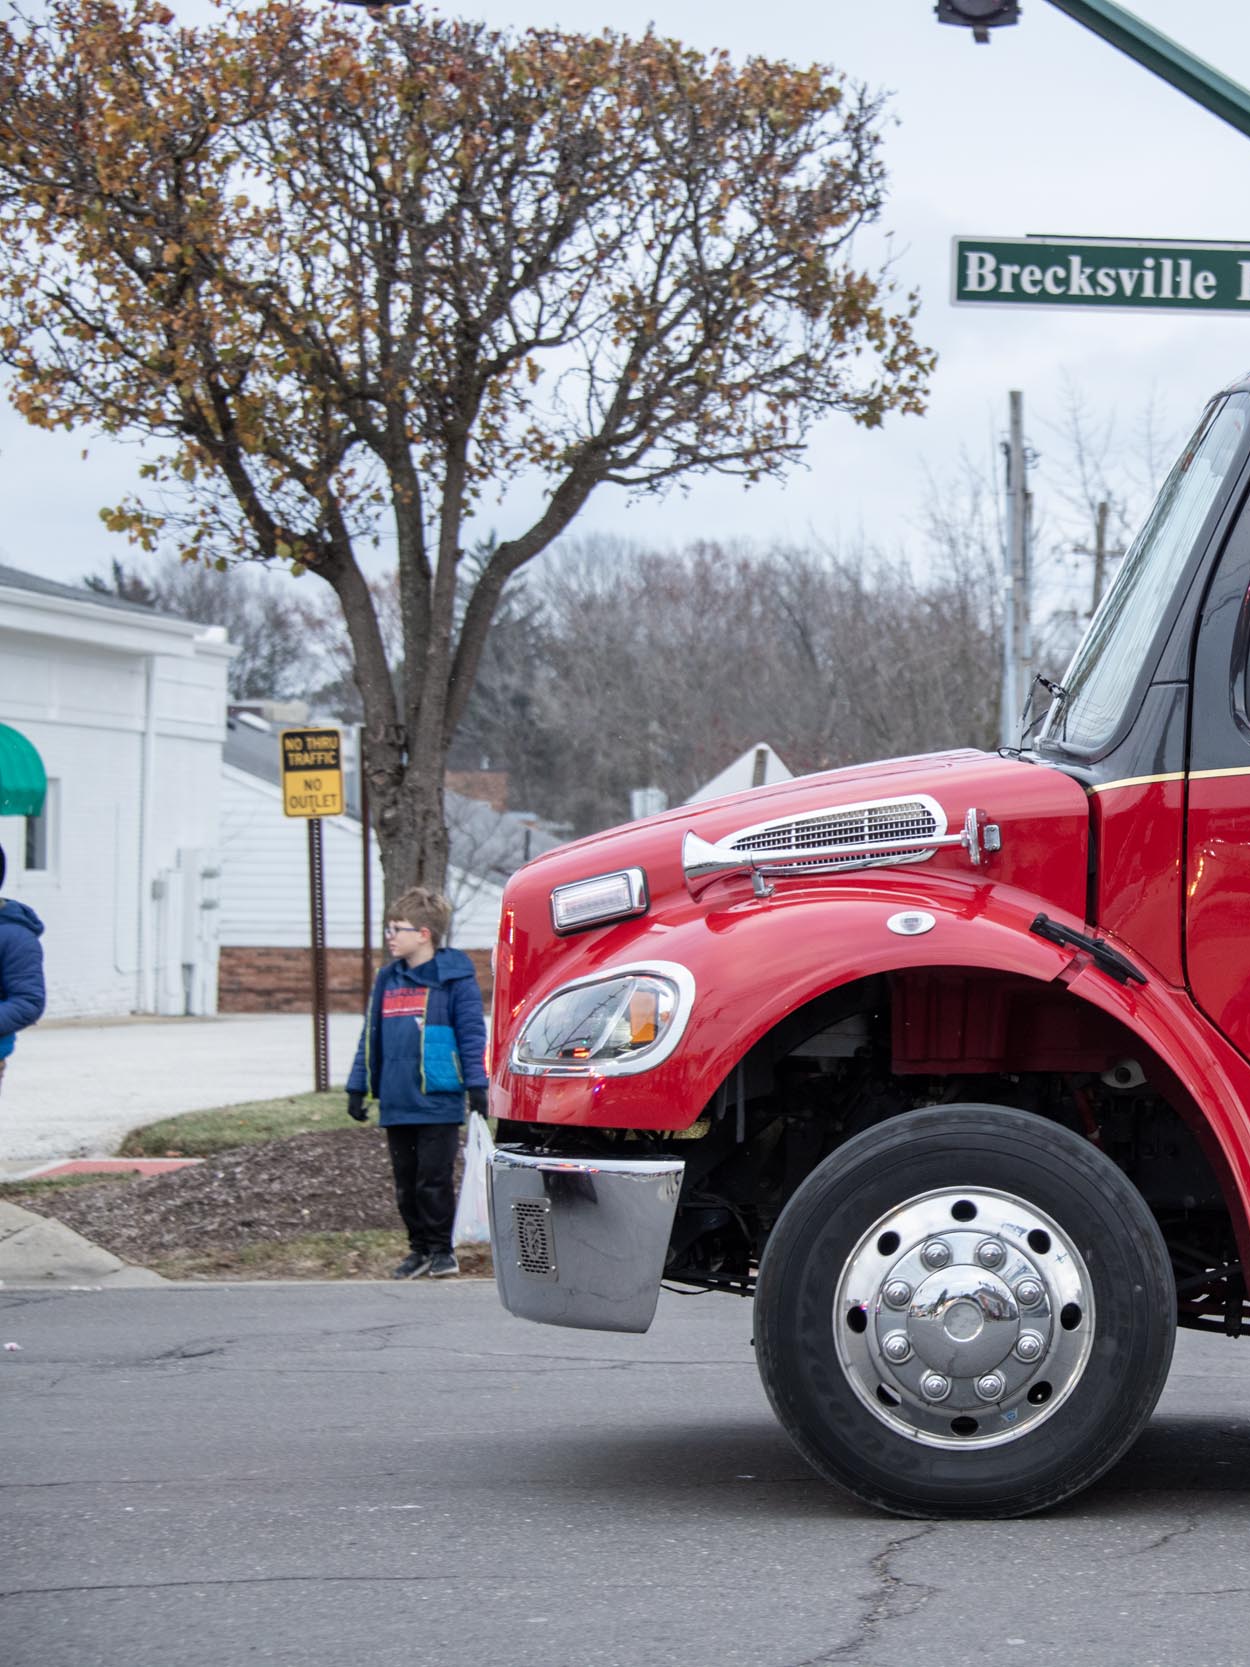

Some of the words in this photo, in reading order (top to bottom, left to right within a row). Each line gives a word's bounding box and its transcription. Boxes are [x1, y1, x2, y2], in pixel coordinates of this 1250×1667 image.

[962, 251, 1217, 300] Brecksville
[284, 737, 303, 751] NO
[306, 736, 338, 750] THRU
[288, 752, 337, 766] TRAFFIC
[303, 779, 322, 791] NO
[289, 794, 337, 809] OUTLET
